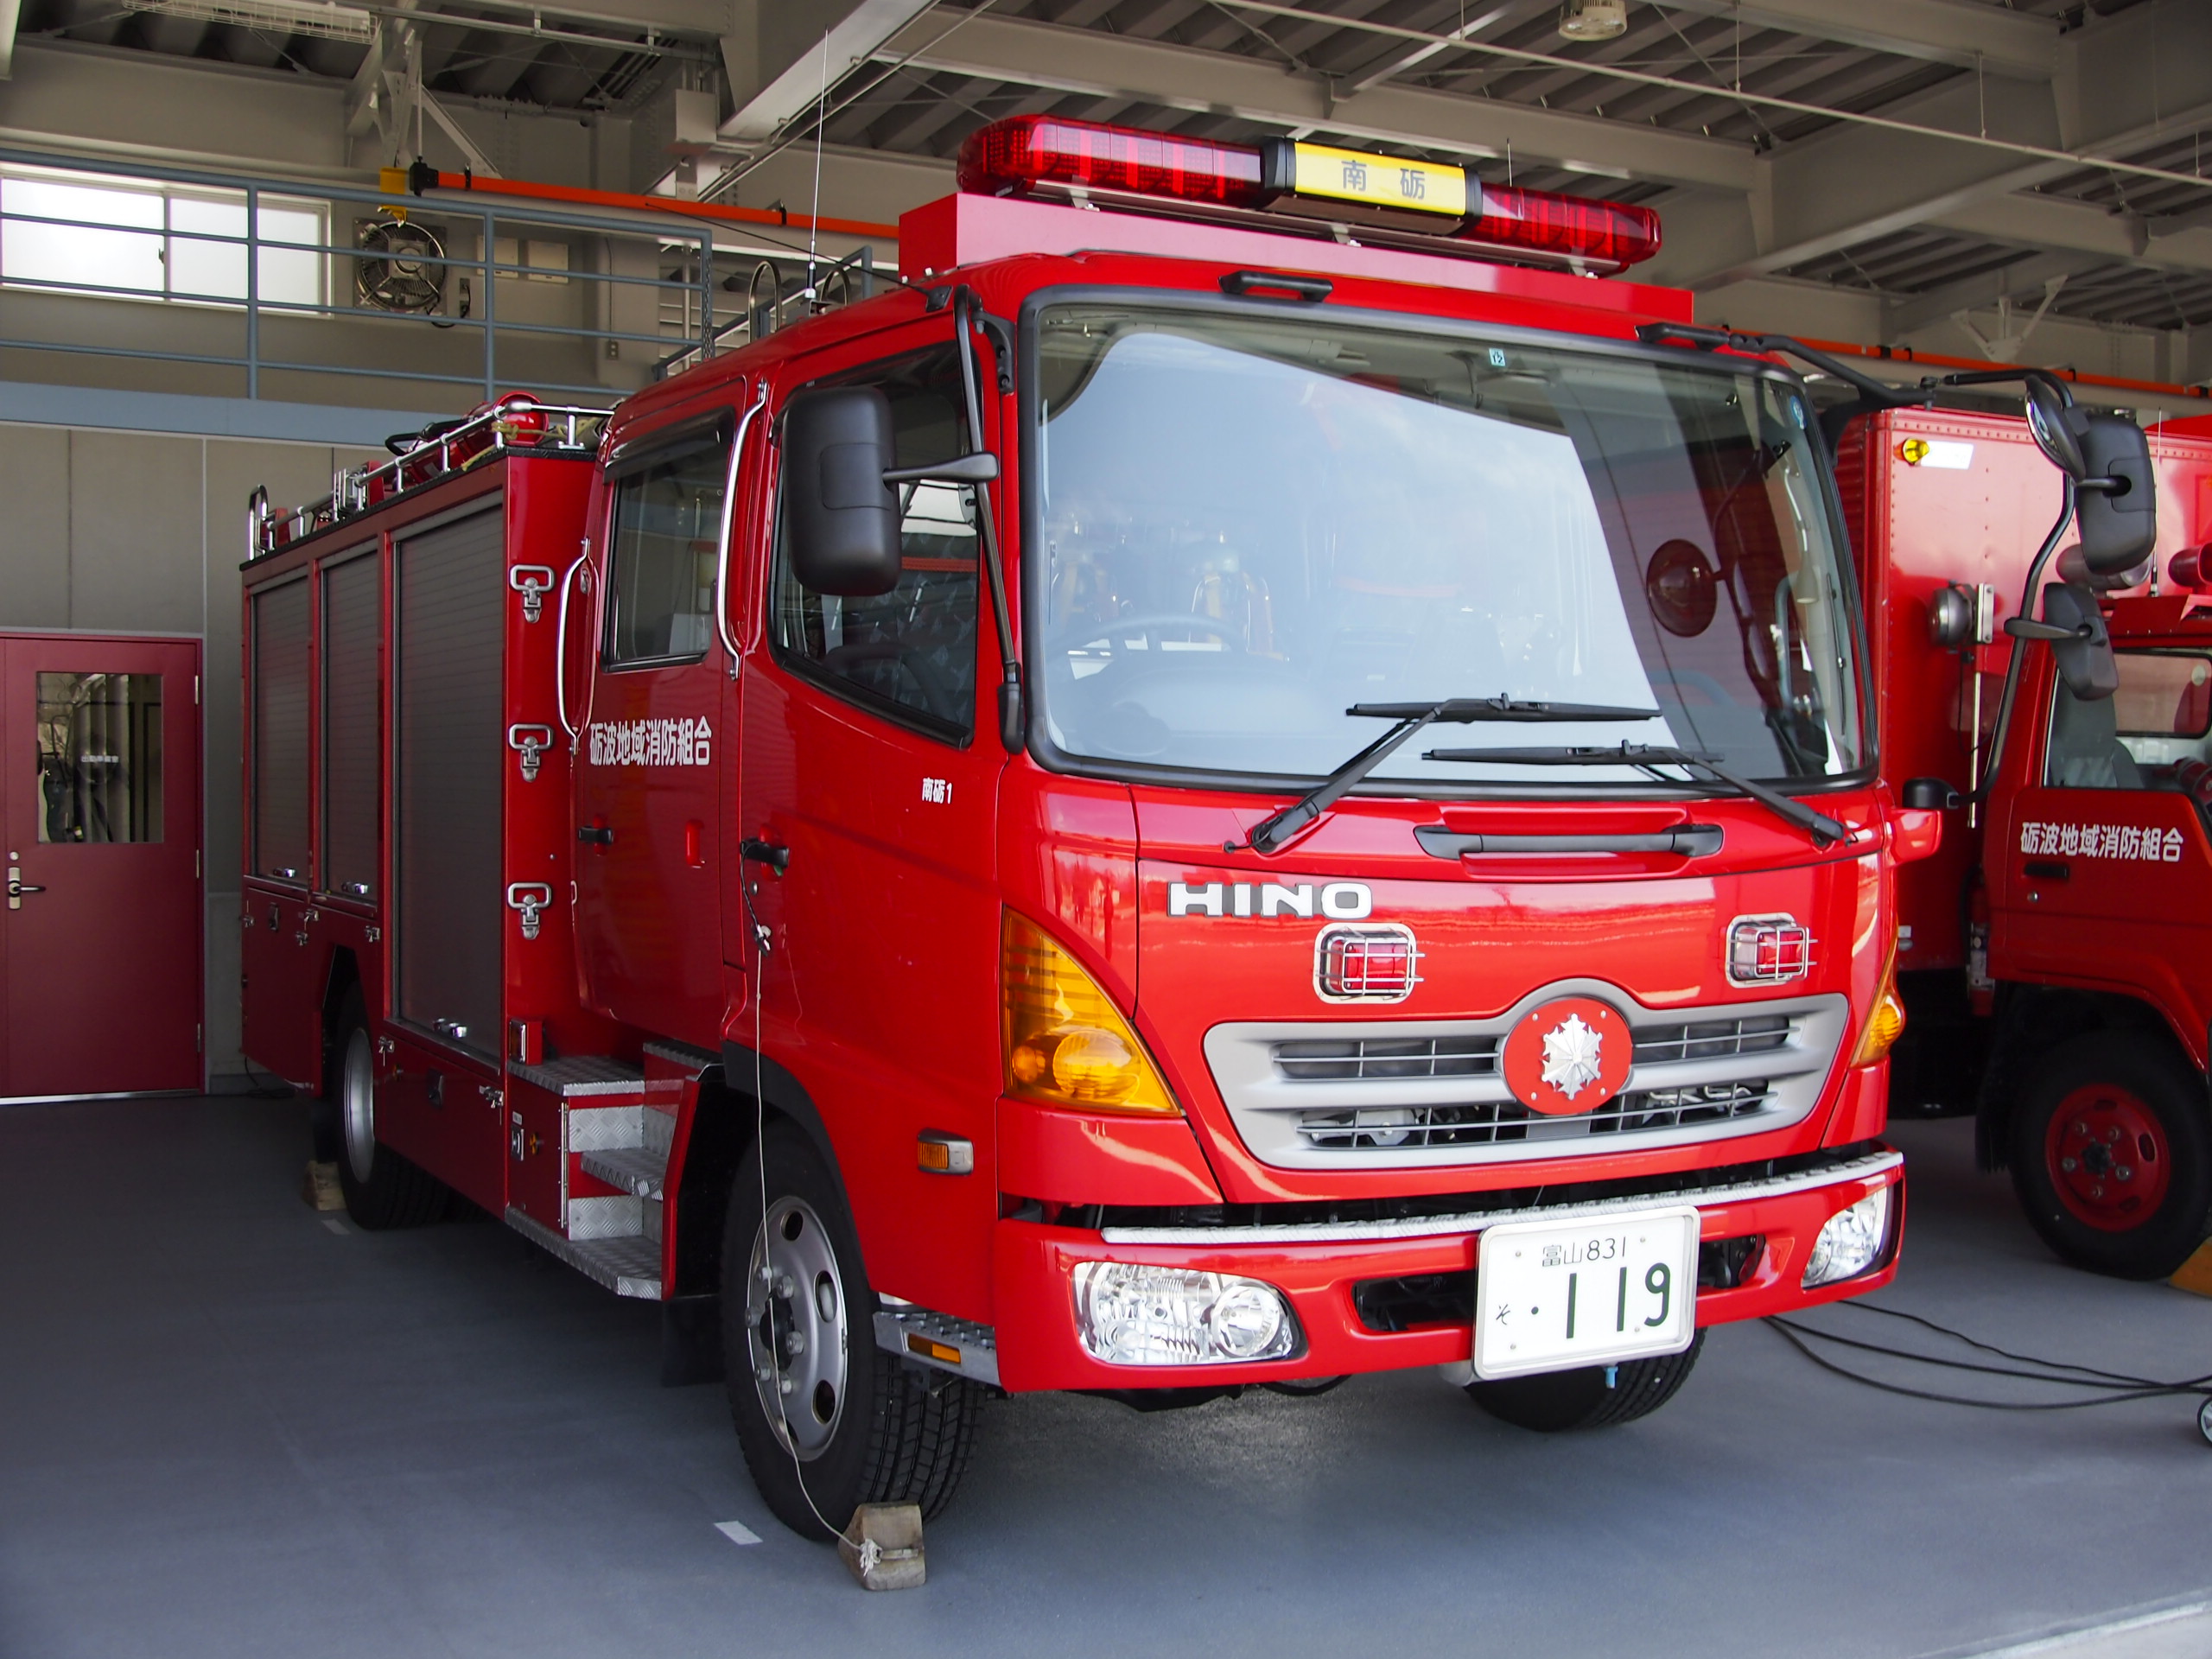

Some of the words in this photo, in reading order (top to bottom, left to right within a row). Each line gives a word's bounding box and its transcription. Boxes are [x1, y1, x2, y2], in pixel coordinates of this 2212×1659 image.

[589, 715, 713, 767] 砺波地域消防組合
[2019, 821, 2184, 862] 砺波地域消防組合
[1168, 881, 1372, 919] HINO
